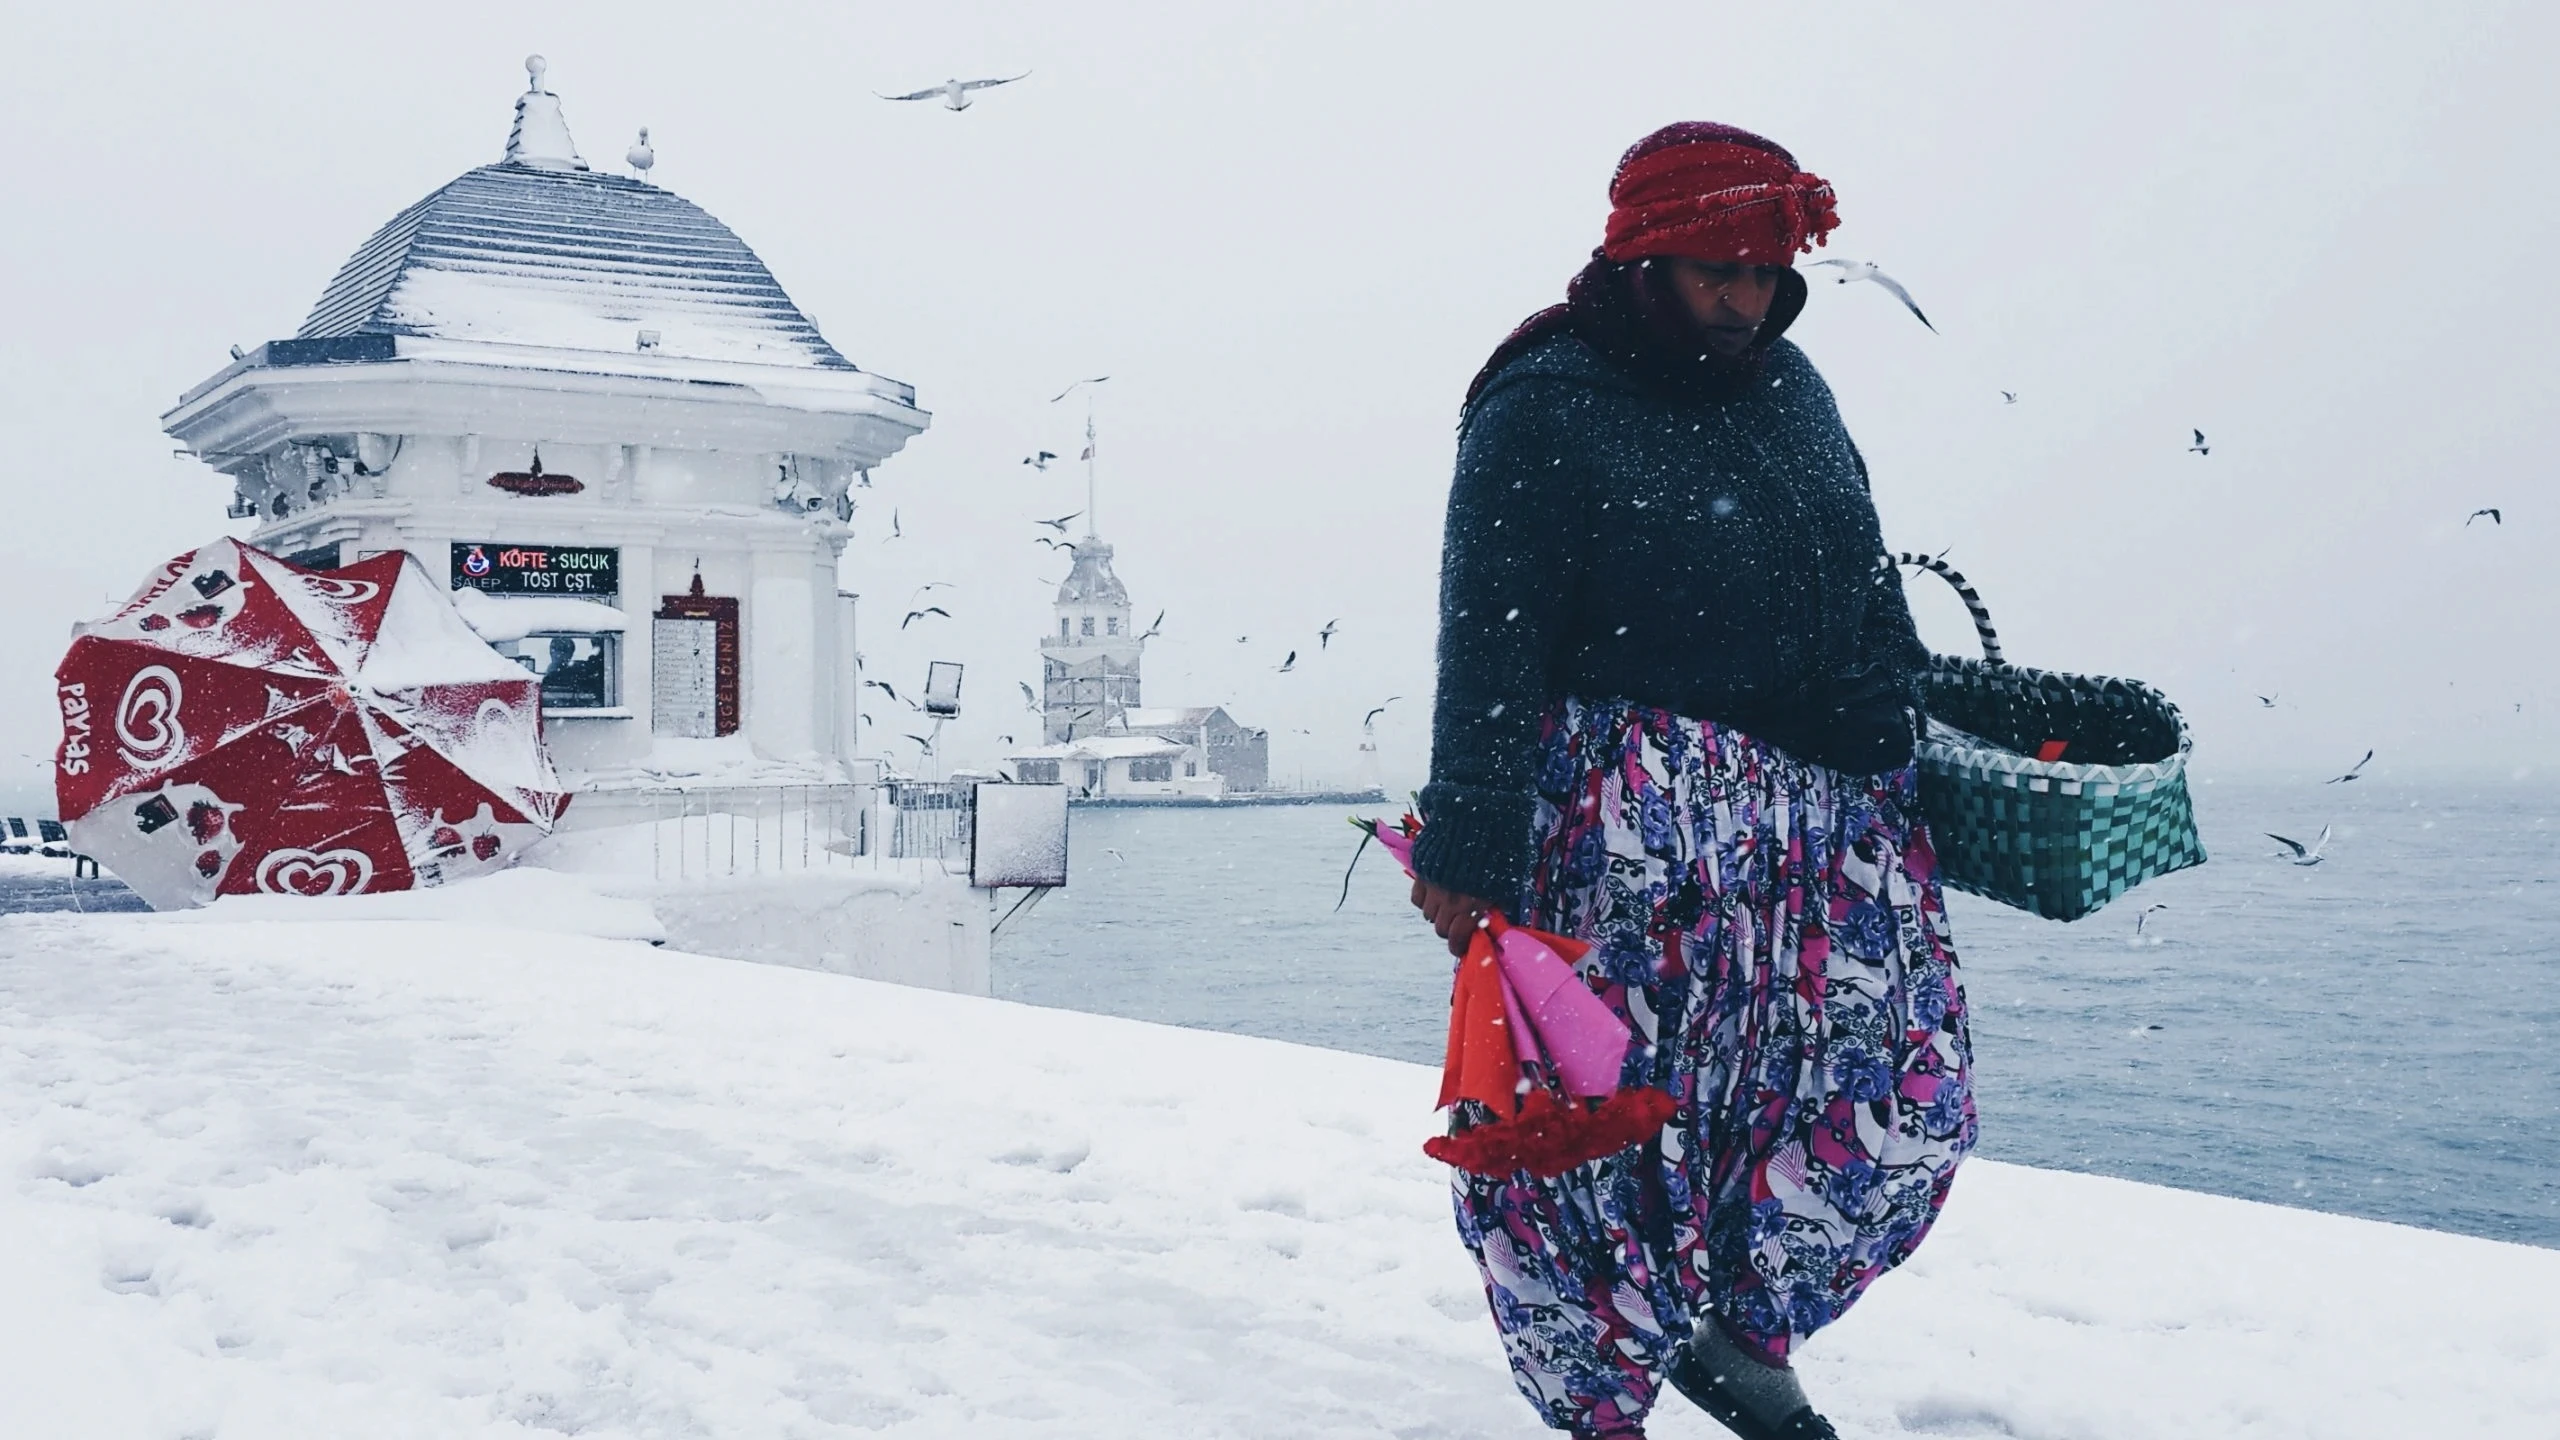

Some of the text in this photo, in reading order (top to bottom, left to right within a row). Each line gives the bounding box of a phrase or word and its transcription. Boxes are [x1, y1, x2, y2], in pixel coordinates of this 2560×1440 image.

[499, 549, 609, 570] KÖFTE SUCUK
[452, 576, 501, 589] SALEP
[521, 571, 559, 588] TOST
